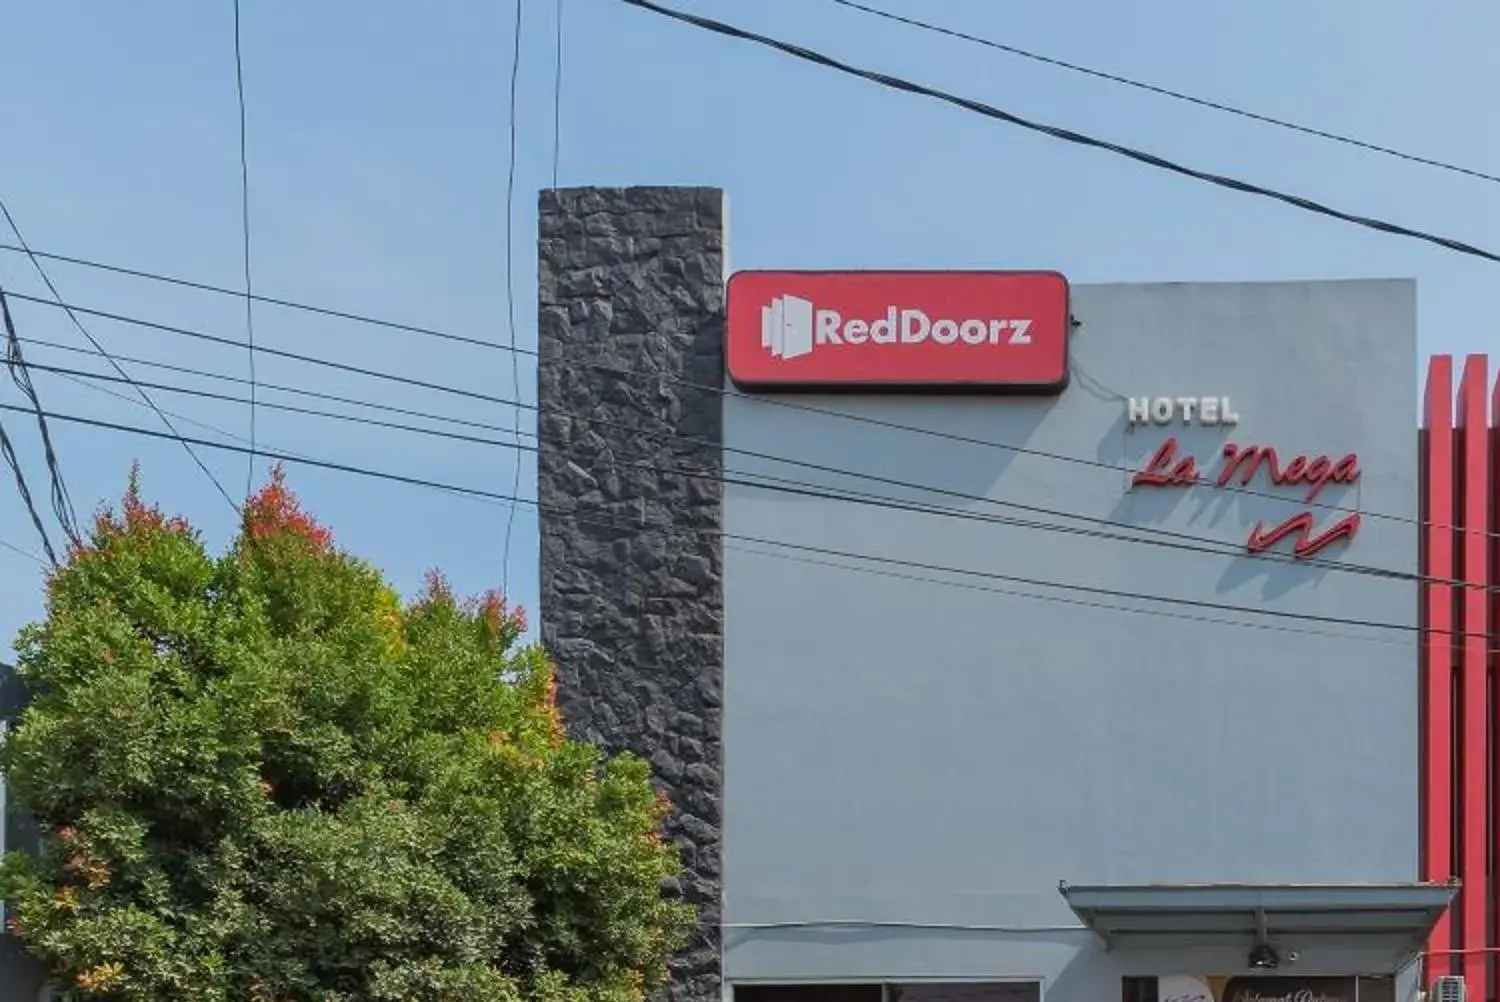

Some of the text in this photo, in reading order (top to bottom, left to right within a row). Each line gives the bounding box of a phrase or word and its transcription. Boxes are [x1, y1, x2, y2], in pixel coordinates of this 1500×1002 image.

[815, 305, 1033, 345] RedDoorz
[1128, 396, 1240, 426] HOTEL
[1131, 436, 1362, 504] La Mega
